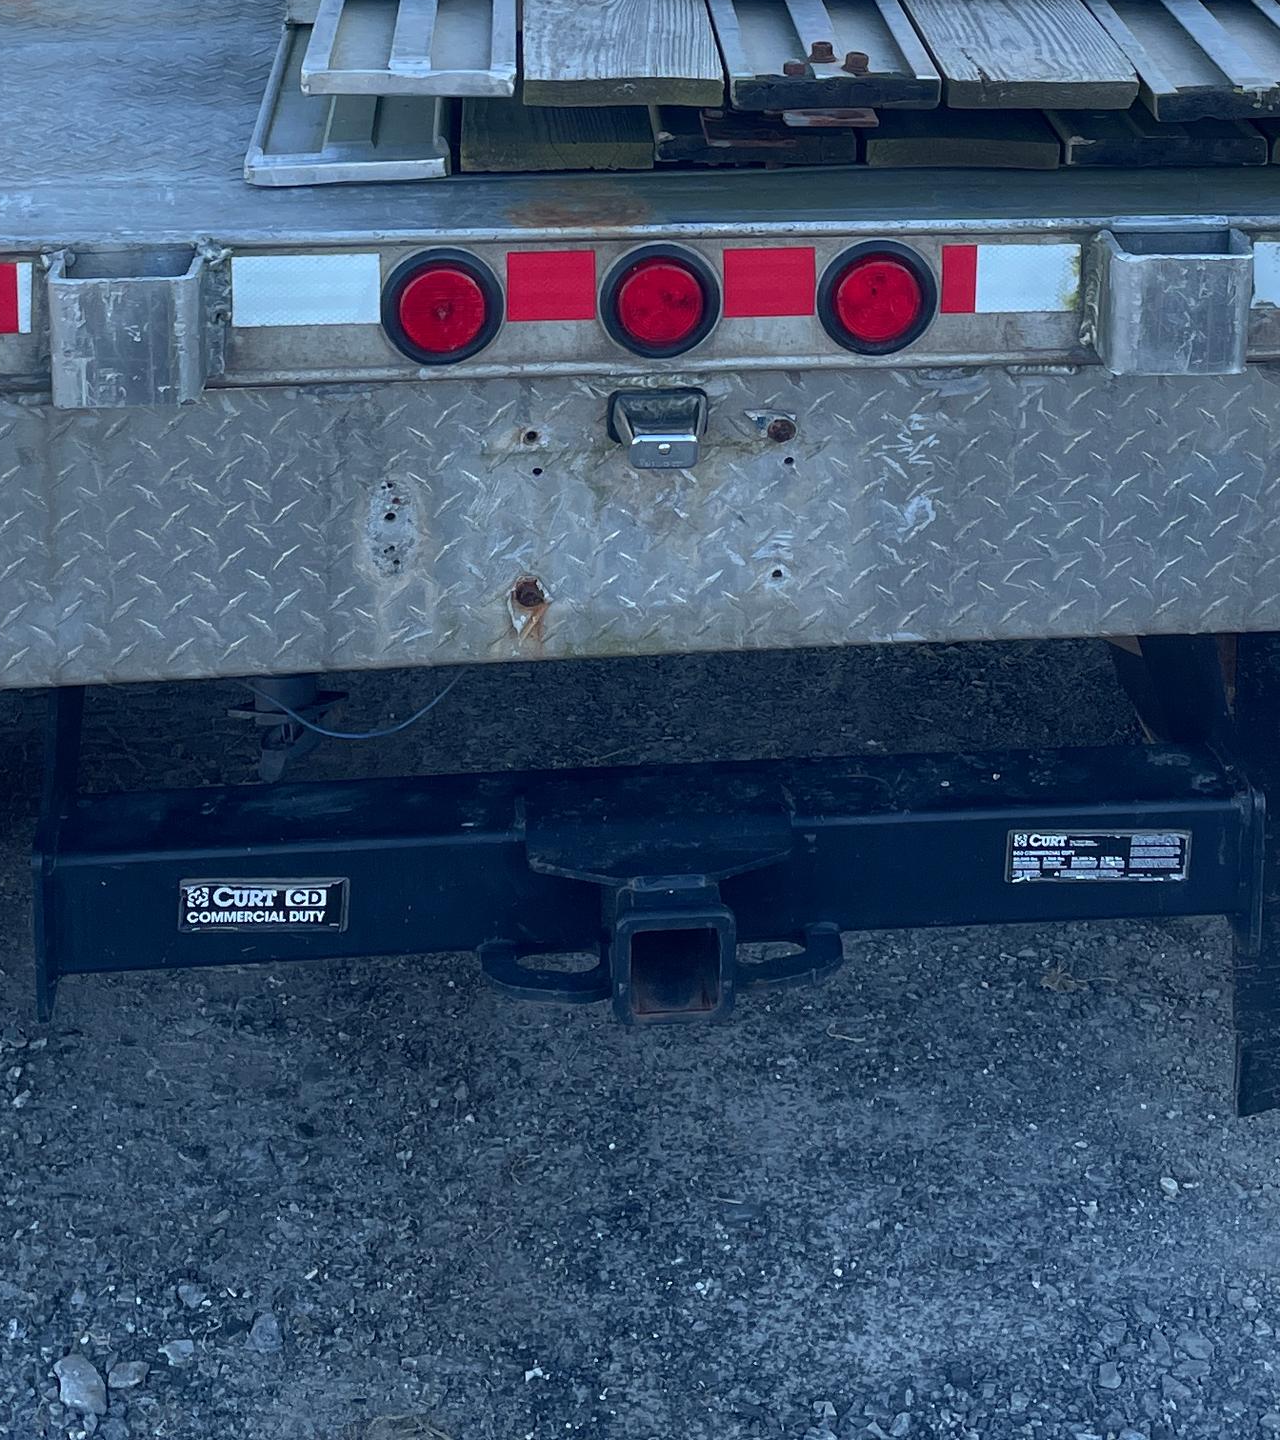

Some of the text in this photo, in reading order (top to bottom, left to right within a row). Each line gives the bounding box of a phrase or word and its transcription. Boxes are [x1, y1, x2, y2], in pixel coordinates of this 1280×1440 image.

[1029, 834, 1068, 848] CURT
[213, 887, 323, 907] CURT CD
[186, 910, 326, 923] COMMERCIAL DUTY
